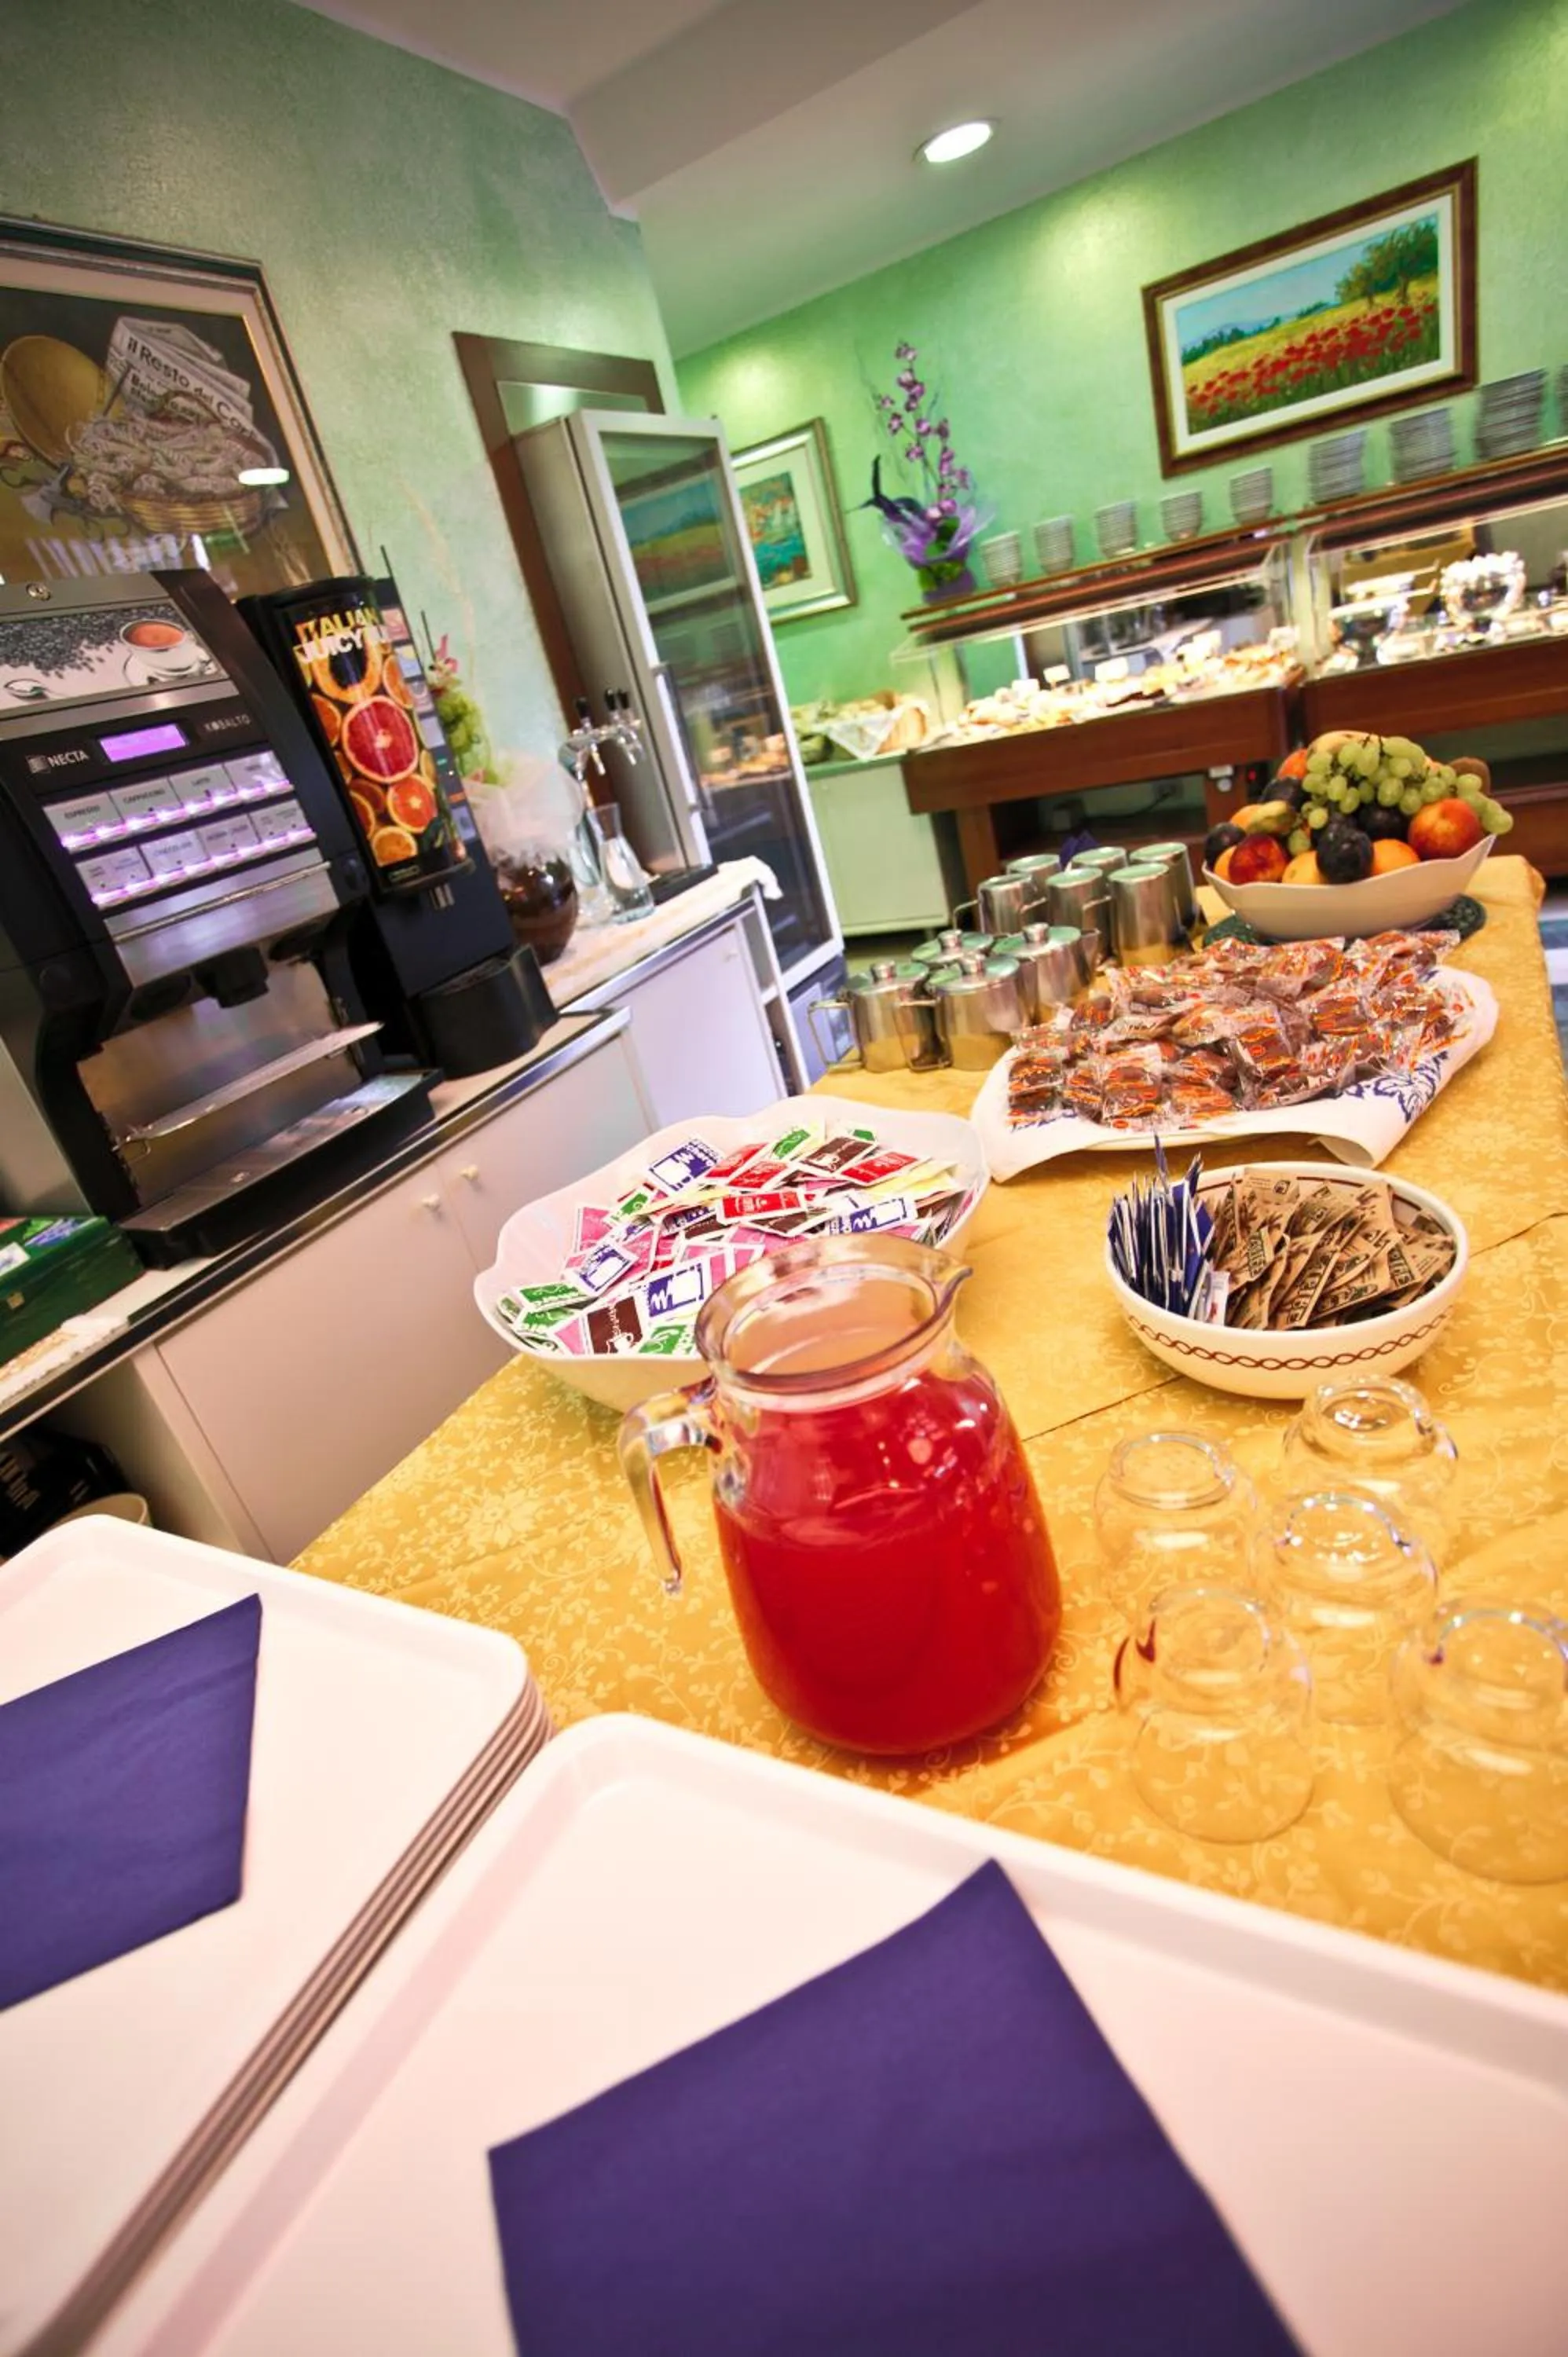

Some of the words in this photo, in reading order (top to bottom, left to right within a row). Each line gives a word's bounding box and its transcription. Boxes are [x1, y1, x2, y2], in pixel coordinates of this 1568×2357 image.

[140, 344, 191, 389] Resto
[295, 607, 380, 643] ITALIAN
[298, 629, 363, 664] JUICY
[47, 749, 90, 768] NECTA
